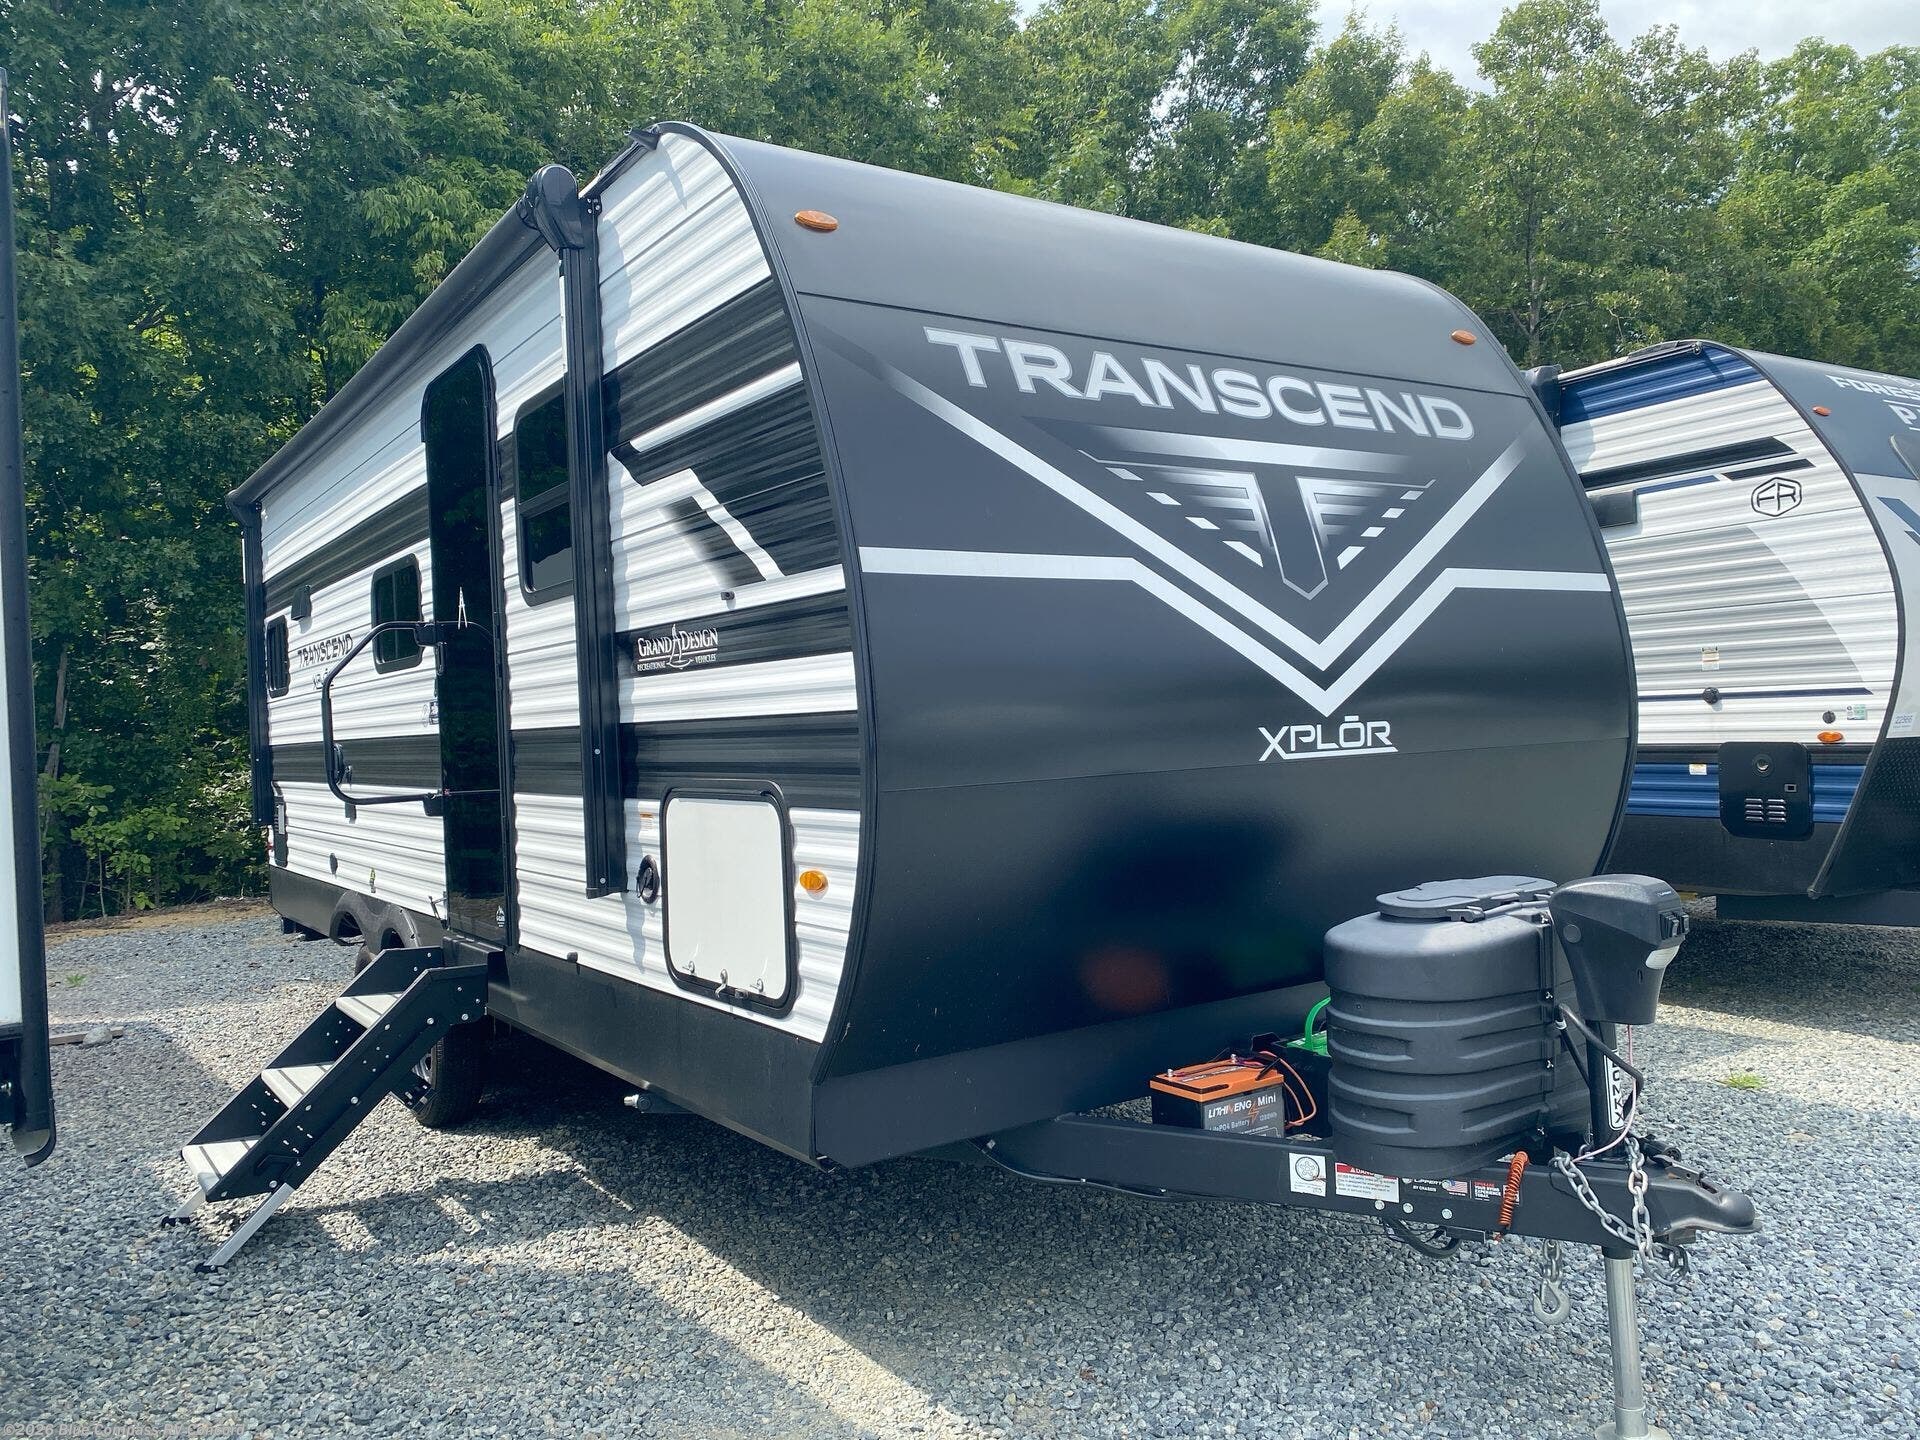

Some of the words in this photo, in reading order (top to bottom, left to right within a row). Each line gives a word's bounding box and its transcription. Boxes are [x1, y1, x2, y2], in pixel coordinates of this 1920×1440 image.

[923, 326, 1475, 441] TRANSCEND
[297, 633, 353, 668] TRANSCEND
[637, 637, 673, 657] GRAND
[679, 628, 719, 651] DESIGN
[1257, 1092, 1276, 1107] Mini
[1231, 1119, 1250, 1129] Battery
